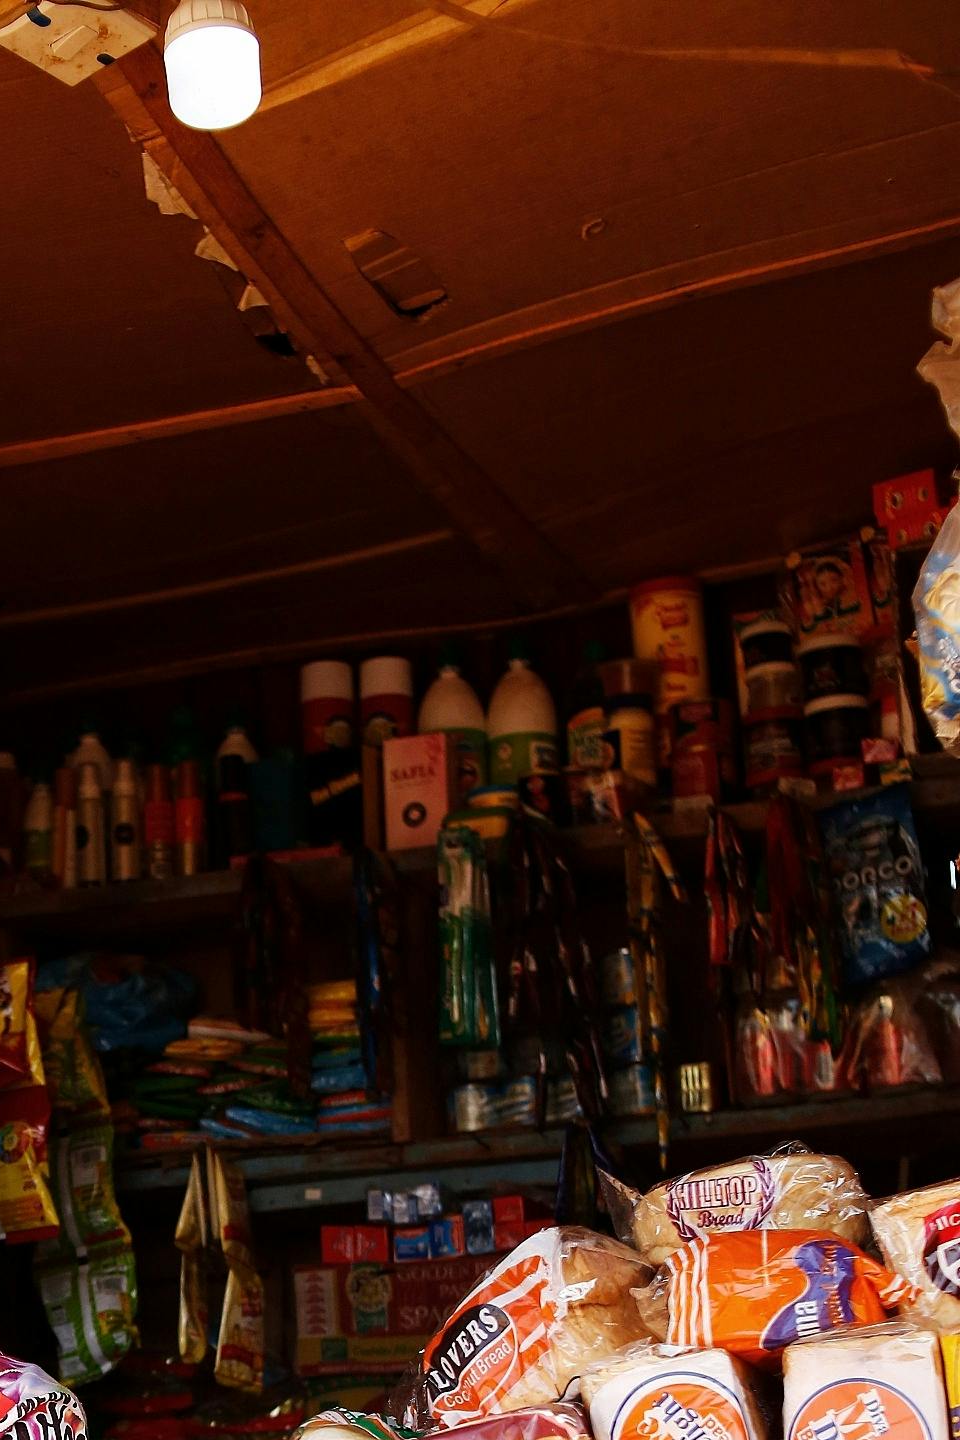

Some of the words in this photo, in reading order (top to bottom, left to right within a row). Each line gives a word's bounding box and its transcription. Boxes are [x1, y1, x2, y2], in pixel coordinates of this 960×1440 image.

[674, 1175, 758, 1212] HILLTOP
[697, 1210, 746, 1229] Bread
[430, 1307, 500, 1390] LOVERS
[443, 1371, 479, 1409] Cocnut
[477, 1338, 513, 1377] Bread
[862, 1396, 889, 1438] Diva
